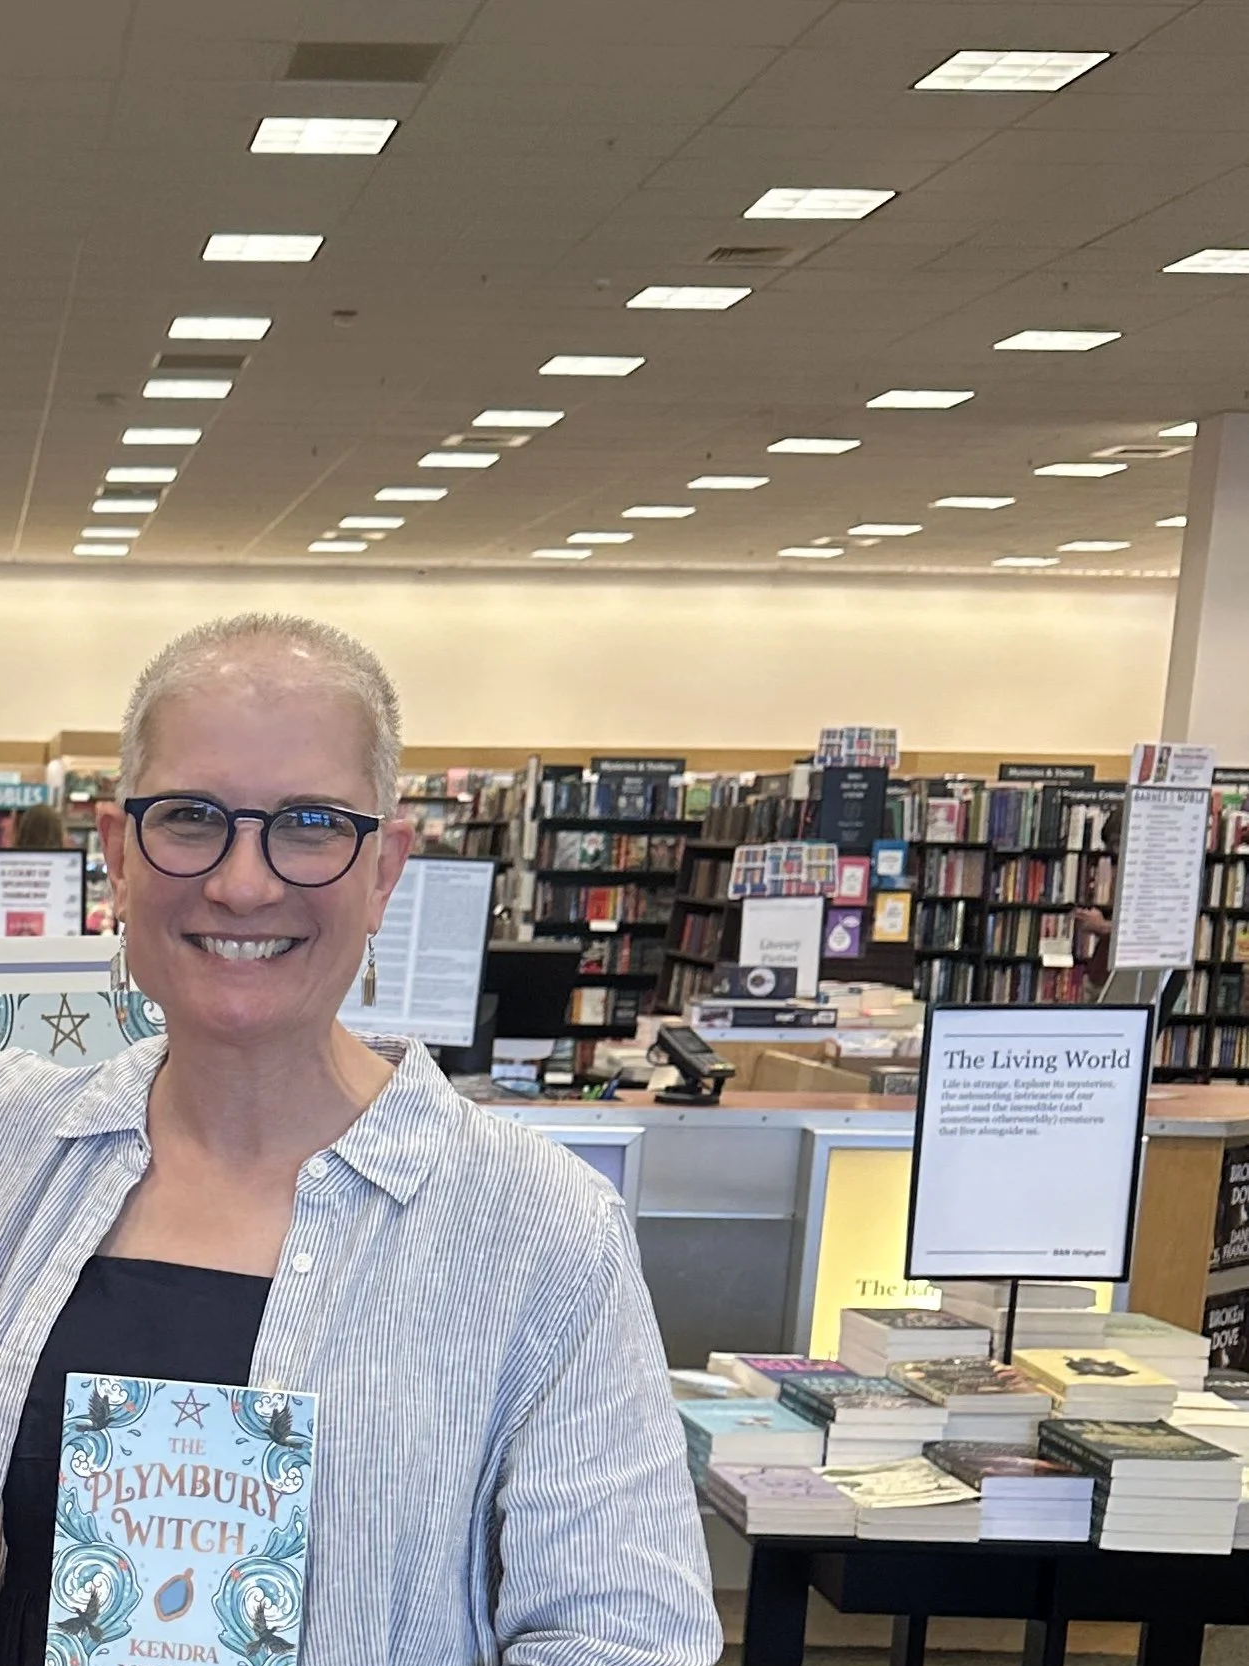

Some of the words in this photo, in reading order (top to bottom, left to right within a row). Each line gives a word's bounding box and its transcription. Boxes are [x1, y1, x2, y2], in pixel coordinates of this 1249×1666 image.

[943, 1049, 985, 1070] The
[992, 1049, 1057, 1073] Living
[1065, 1048, 1131, 1070] World
[943, 1078, 962, 1089] Life
[962, 1079, 971, 1089] is
[973, 1079, 1010, 1092] strange.
[1014, 1078, 1051, 1091] Explore
[1053, 1079, 1065, 1089] its
[1067, 1079, 1117, 1092] mysteries,
[941, 1091, 957, 1101] the
[959, 1091, 1012, 1104] astounding
[1014, 1091, 1063, 1101] intricacies
[1064, 1088, 1077, 1103] of
[1077, 1093, 1094, 1101] our
[941, 1103, 970, 1114] planet
[972, 1103, 990, 1112] and
[993, 1103, 1008, 1112] the
[1009, 1102, 1057, 1112] incredible
[1059, 1102, 1083, 1113] (and
[940, 1115, 990, 1124] sometimes
[992, 1114, 1057, 1126] otherworldly)
[1059, 1115, 1104, 1124] creatures
[939, 1126, 957, 1136] that
[959, 1126, 976, 1136] live
[978, 1126, 1024, 1138] alongside
[1026, 1127, 1041, 1137] us.
[855, 1278, 898, 1297] The
[1211, 1326, 1240, 1351] DOVE
[168, 1436, 207, 1456] THE
[84, 1462, 284, 1523] PLYMBURY
[111, 1507, 247, 1556] WITCH
[128, 1638, 220, 1665] KENDRA
